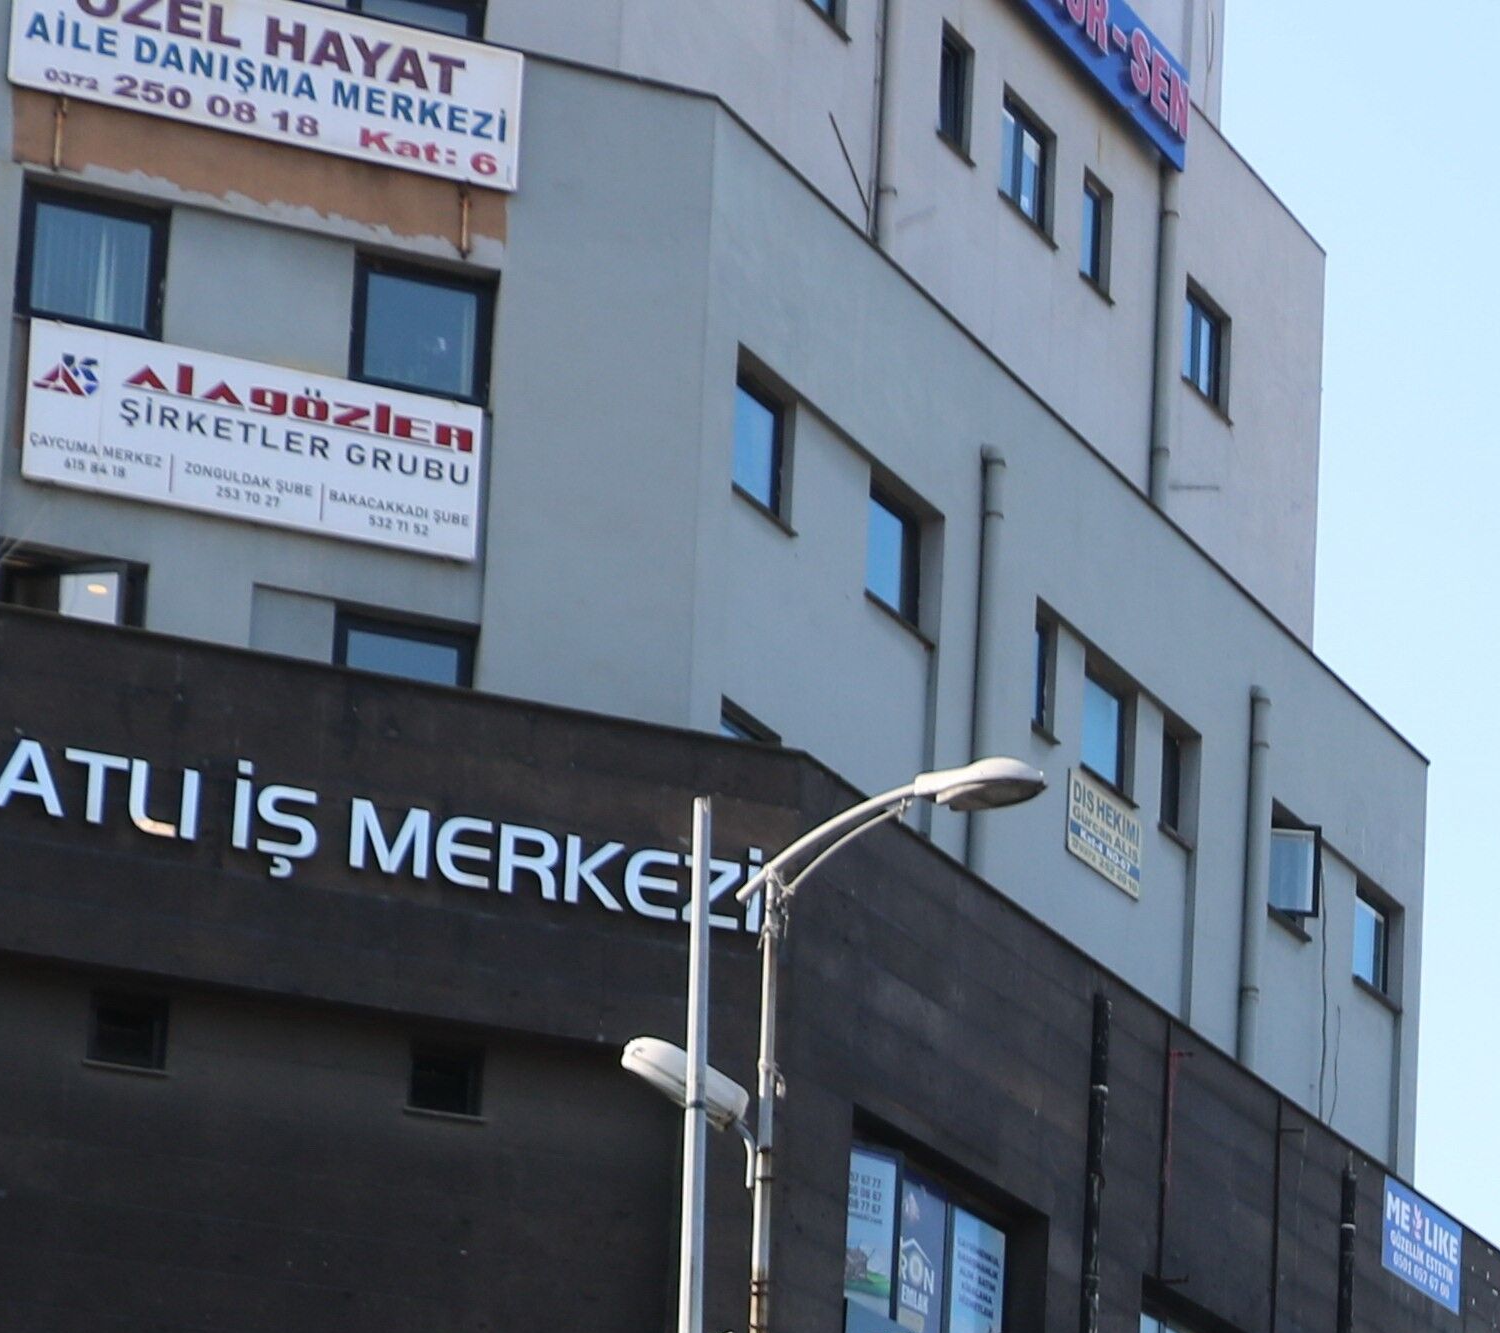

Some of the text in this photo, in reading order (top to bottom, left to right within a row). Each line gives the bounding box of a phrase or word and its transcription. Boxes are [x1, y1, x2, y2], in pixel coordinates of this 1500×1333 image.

[26, 12, 508, 143] AİLE DANIŞMA MERKEZİ
[265, 16, 466, 96] HAYAT
[45, 67, 98, 91] 0372
[114, 75, 192, 109] 250
[206, 95, 257, 124] 08
[272, 109, 319, 137] 18
[470, 153, 498, 176] 6
[29, 432, 162, 469] ÇAYCUMA MERKEZ
[119, 396, 470, 486] ŞİRKETLER GRUBU
[184, 461, 313, 497] ZONGULDAK ŞUBE
[216, 485, 280, 508] 253 70 27
[368, 514, 393, 529] 532
[413, 521, 429, 536] 52
[433, 508, 469, 530] ŞUBE
[232, 758, 319, 879] İŞ
[349, 797, 763, 934] MERKEZİ
[1424, 1217, 1459, 1265] LIKE
